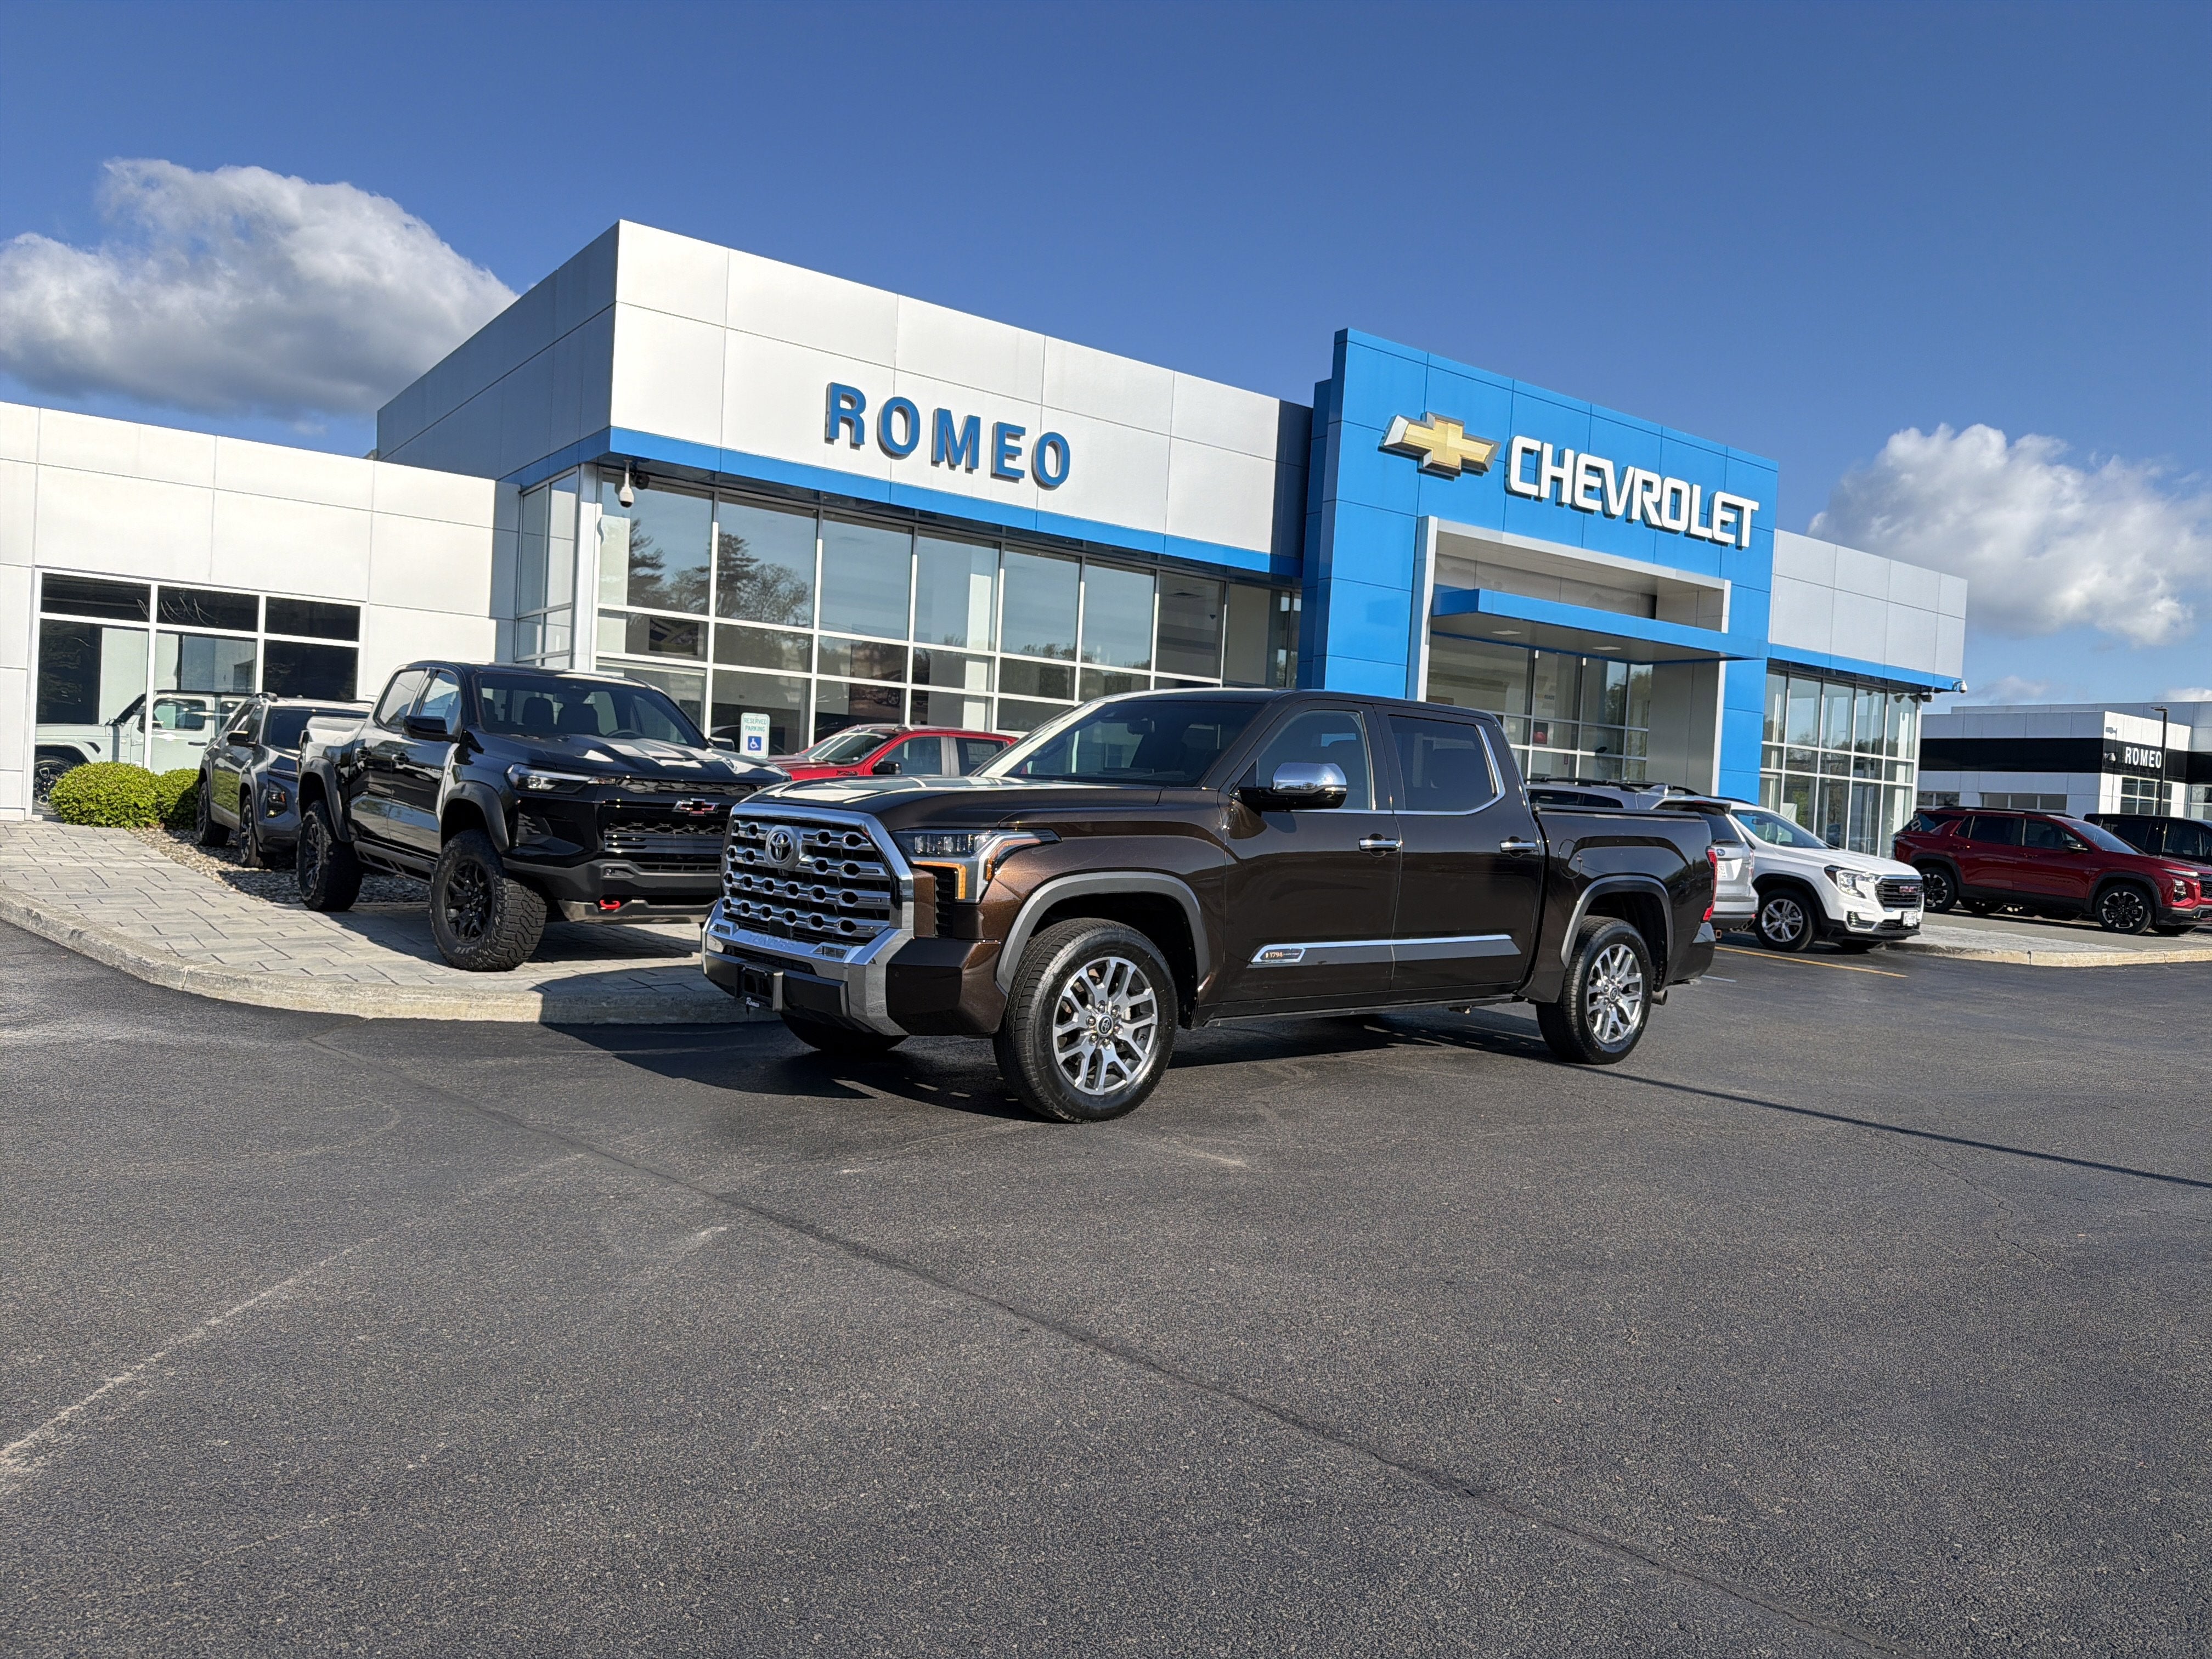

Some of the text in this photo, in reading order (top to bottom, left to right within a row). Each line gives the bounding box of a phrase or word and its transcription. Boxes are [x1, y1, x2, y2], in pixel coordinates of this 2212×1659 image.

[825, 382, 1070, 488] ROMEO
[1506, 435, 1759, 548] CHEVROLET
[2125, 747, 2162, 768] ROMEO
